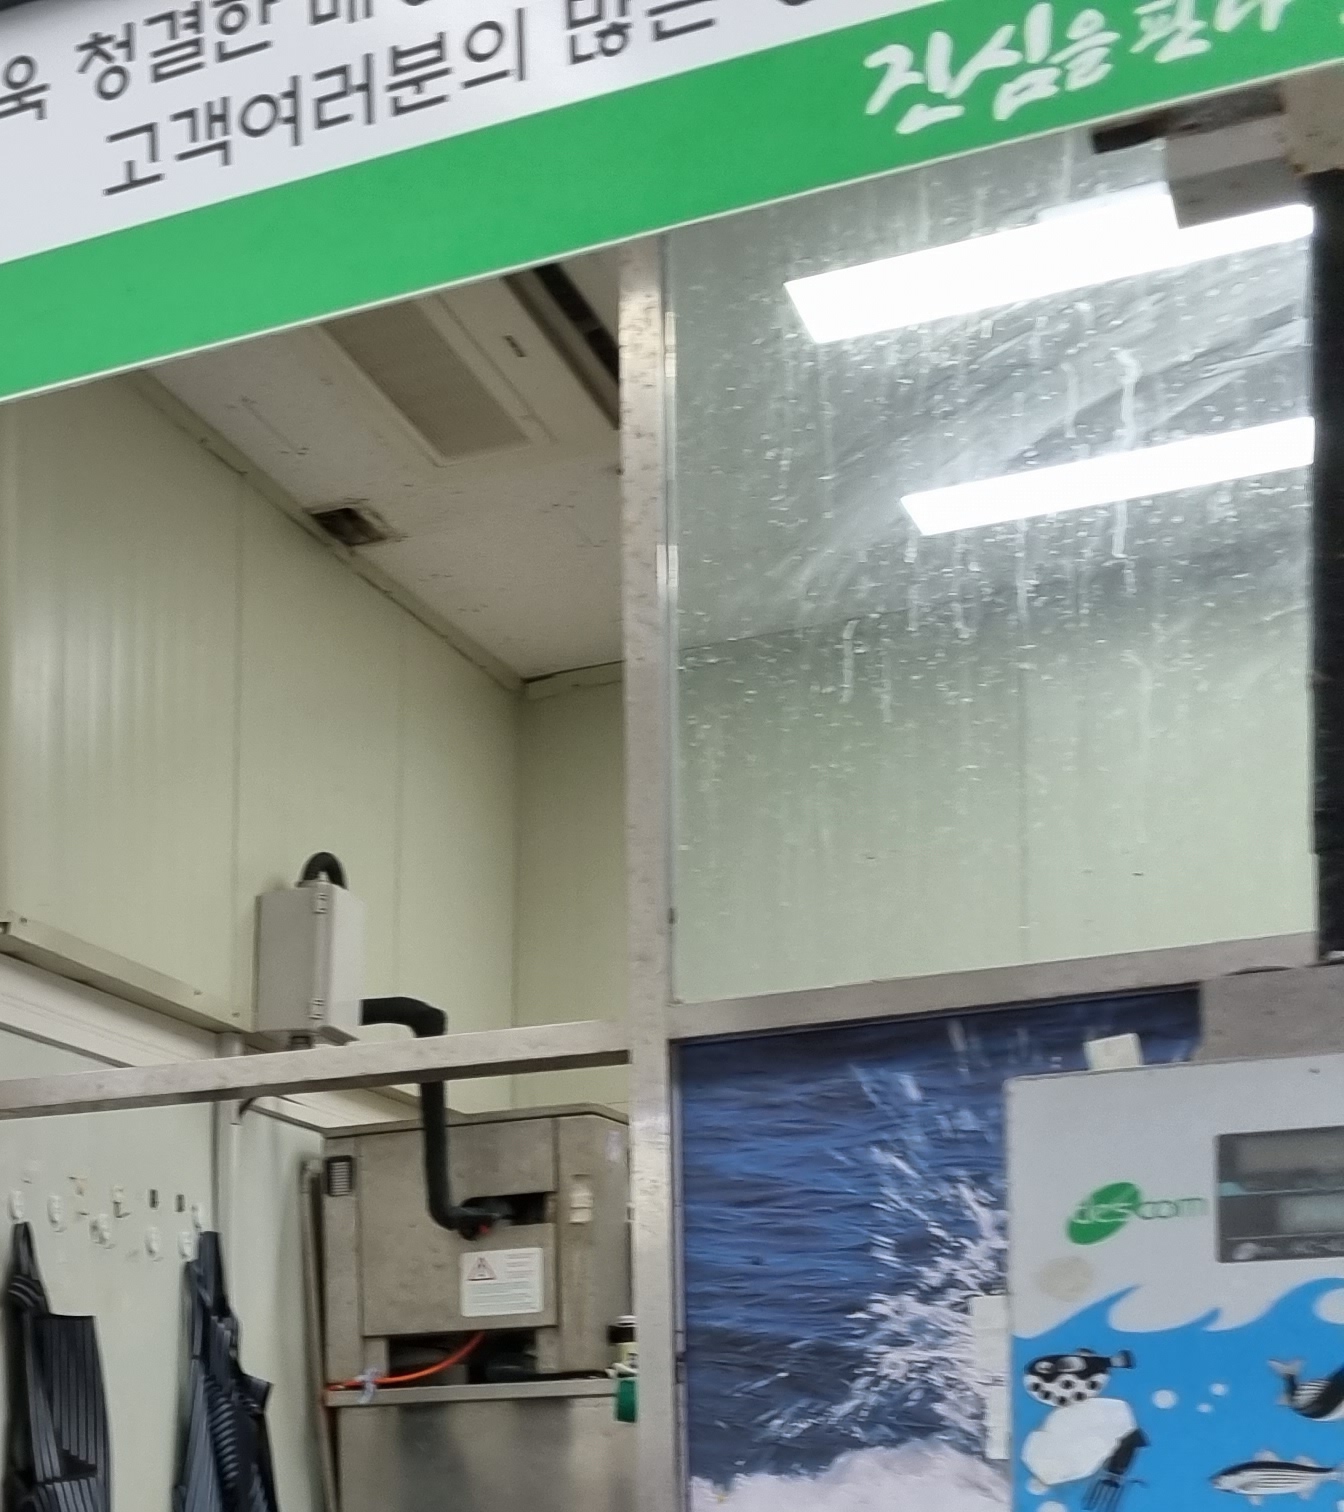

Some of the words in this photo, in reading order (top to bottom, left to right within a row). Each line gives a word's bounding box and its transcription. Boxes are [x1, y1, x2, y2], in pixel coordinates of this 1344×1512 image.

[75, 0, 280, 101] 청결한
[103, 7, 526, 196] 고객여러분의
[863, 2, 1121, 135] 진심을
